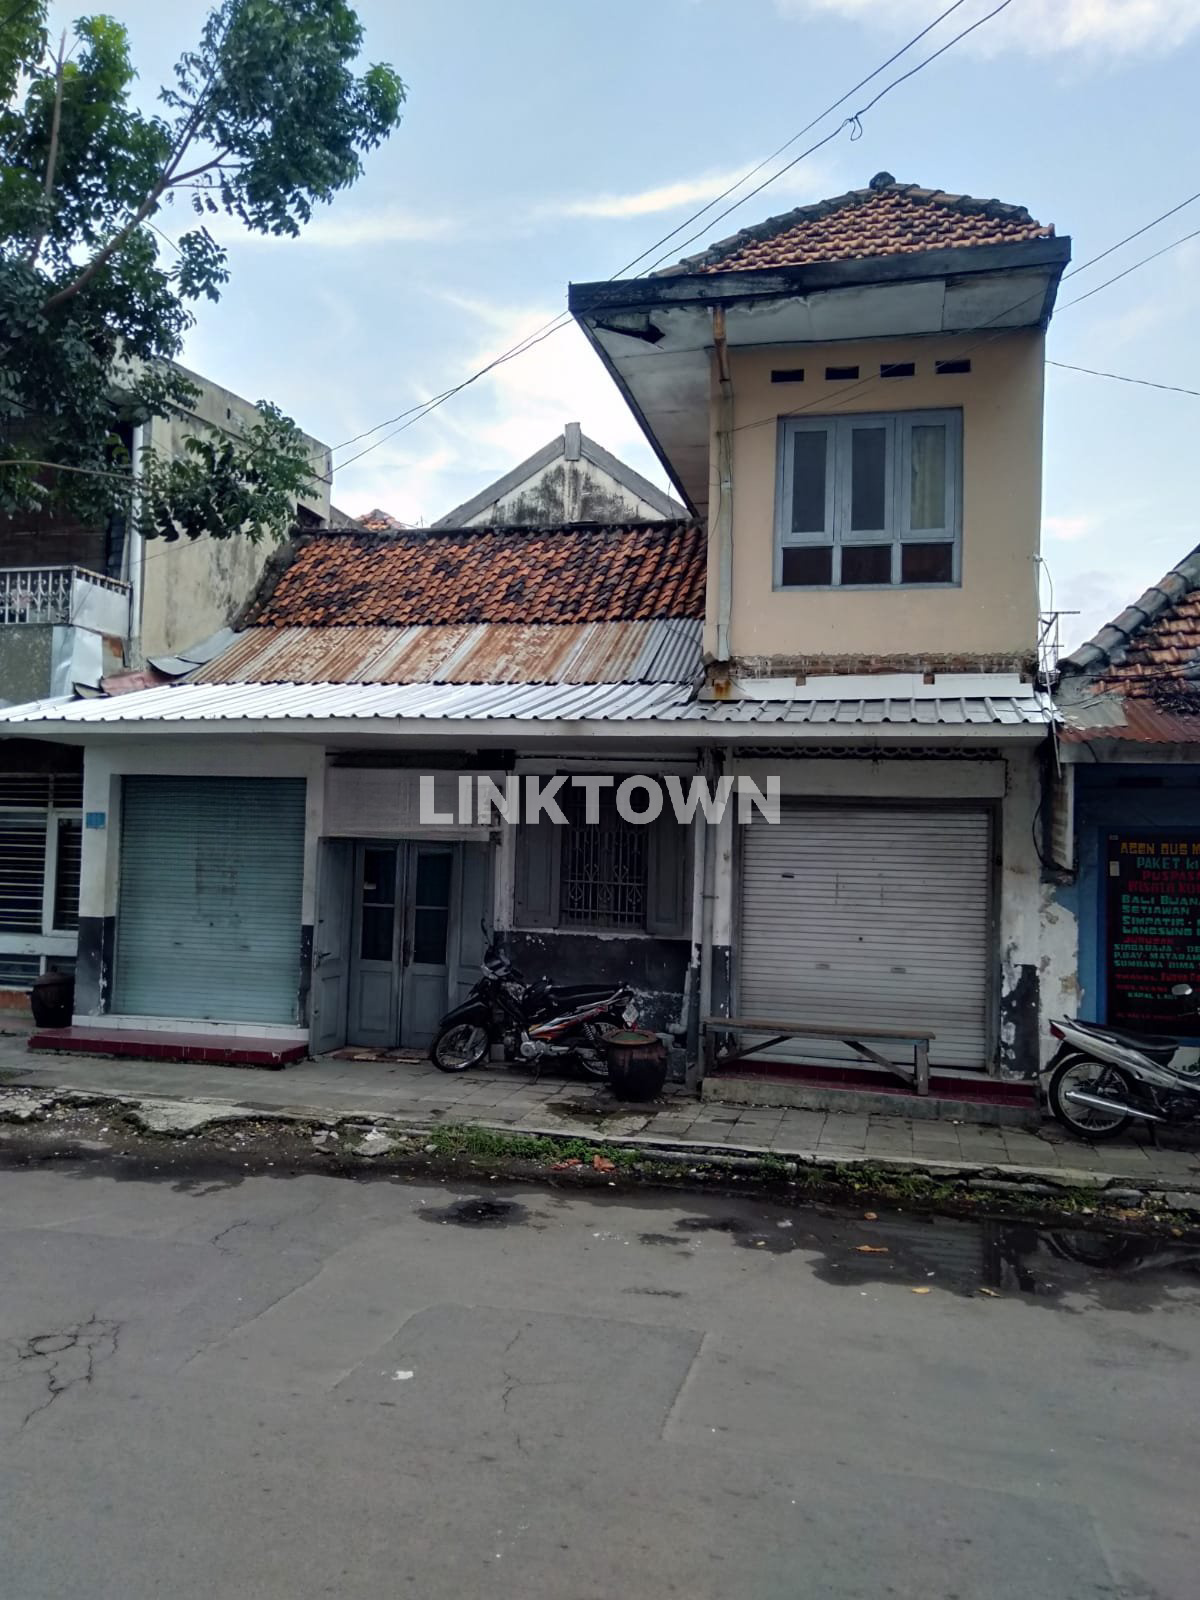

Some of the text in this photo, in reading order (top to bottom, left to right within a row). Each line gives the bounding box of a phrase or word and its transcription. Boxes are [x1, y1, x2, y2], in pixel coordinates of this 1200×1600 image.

[1120, 842, 1155, 855] AGEN
[1161, 842, 1188, 855] BUS
[1136, 856, 1180, 868] PAKET
[1121, 905, 1190, 914] SETIAWAN
